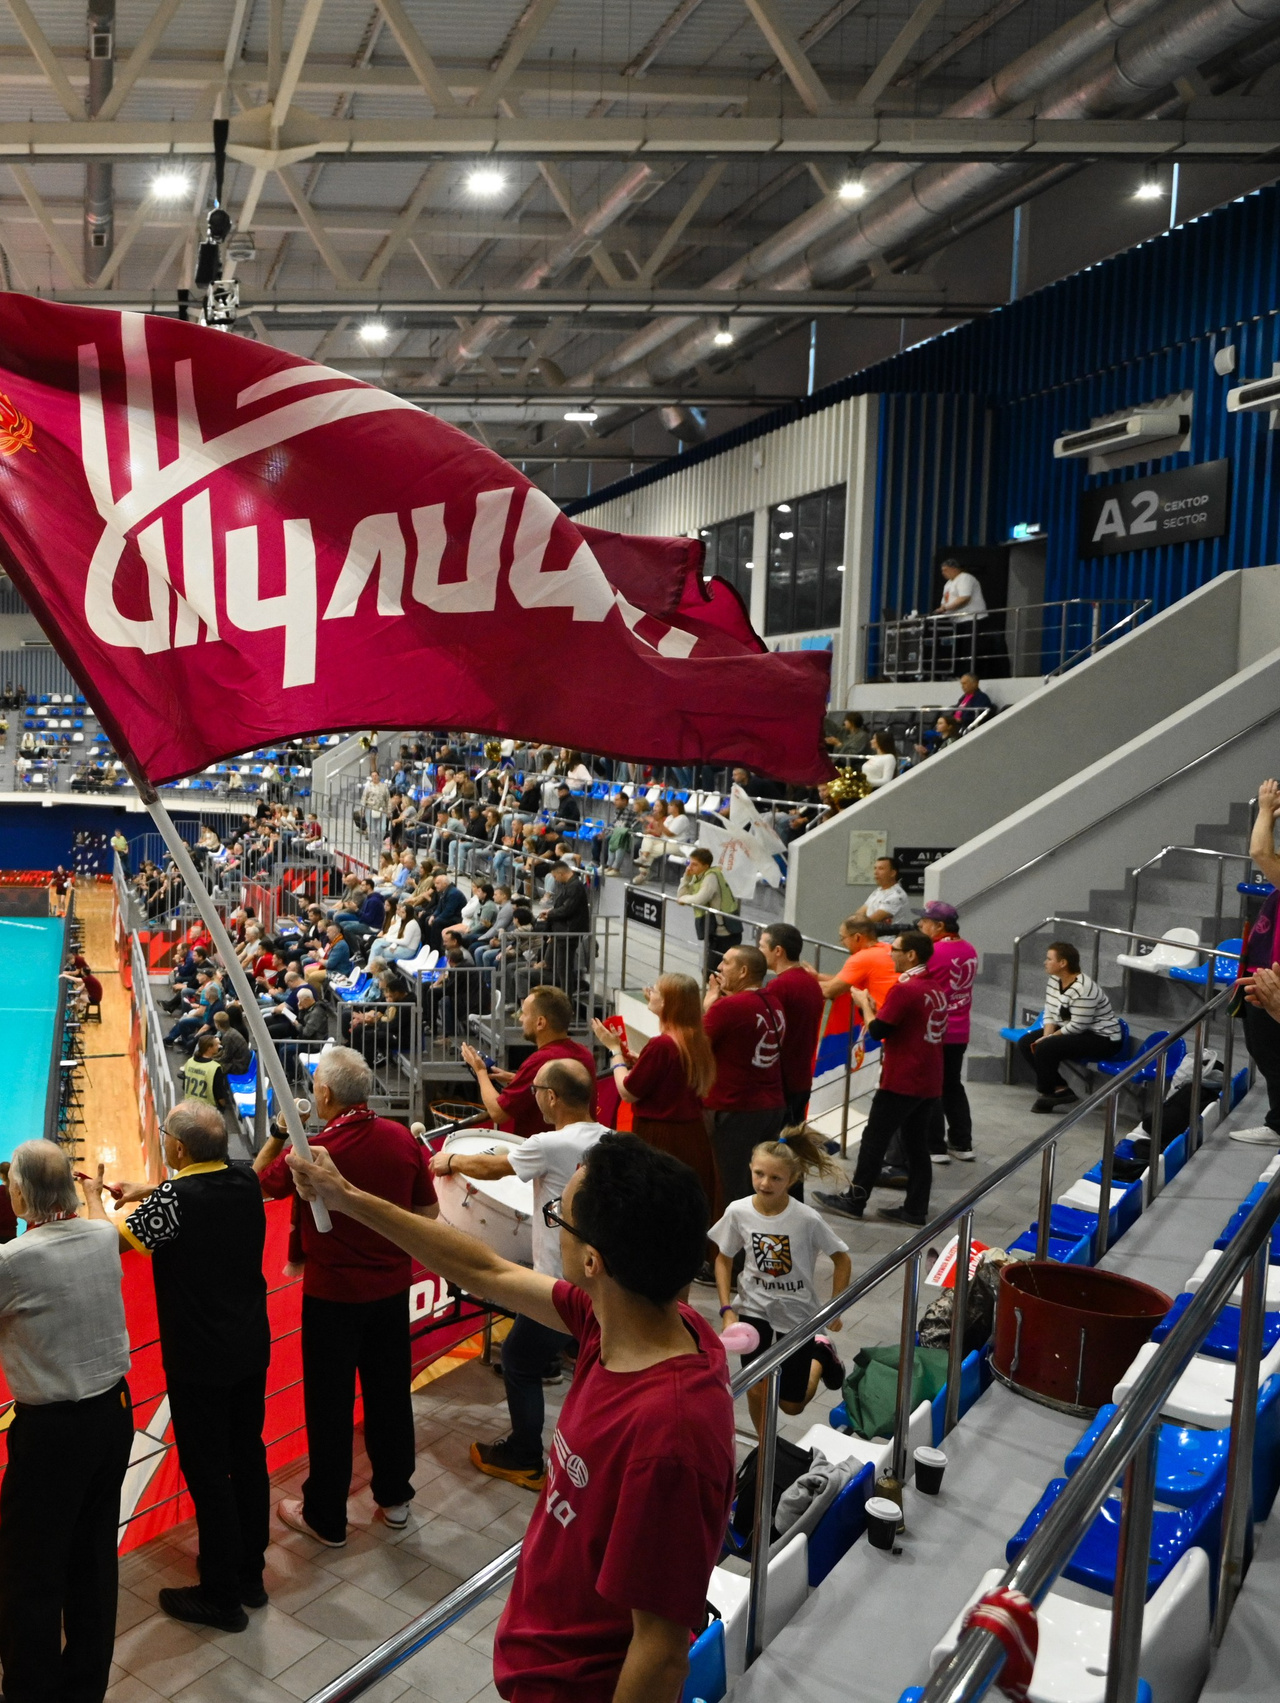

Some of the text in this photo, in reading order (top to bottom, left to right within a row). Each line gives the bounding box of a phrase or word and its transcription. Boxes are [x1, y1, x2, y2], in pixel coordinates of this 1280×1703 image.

[1164, 495, 1209, 512] СЕКТОР
[1091, 490, 1159, 542] A2
[1163, 512, 1208, 529] SECTOR
[643, 902, 657, 922] E2
